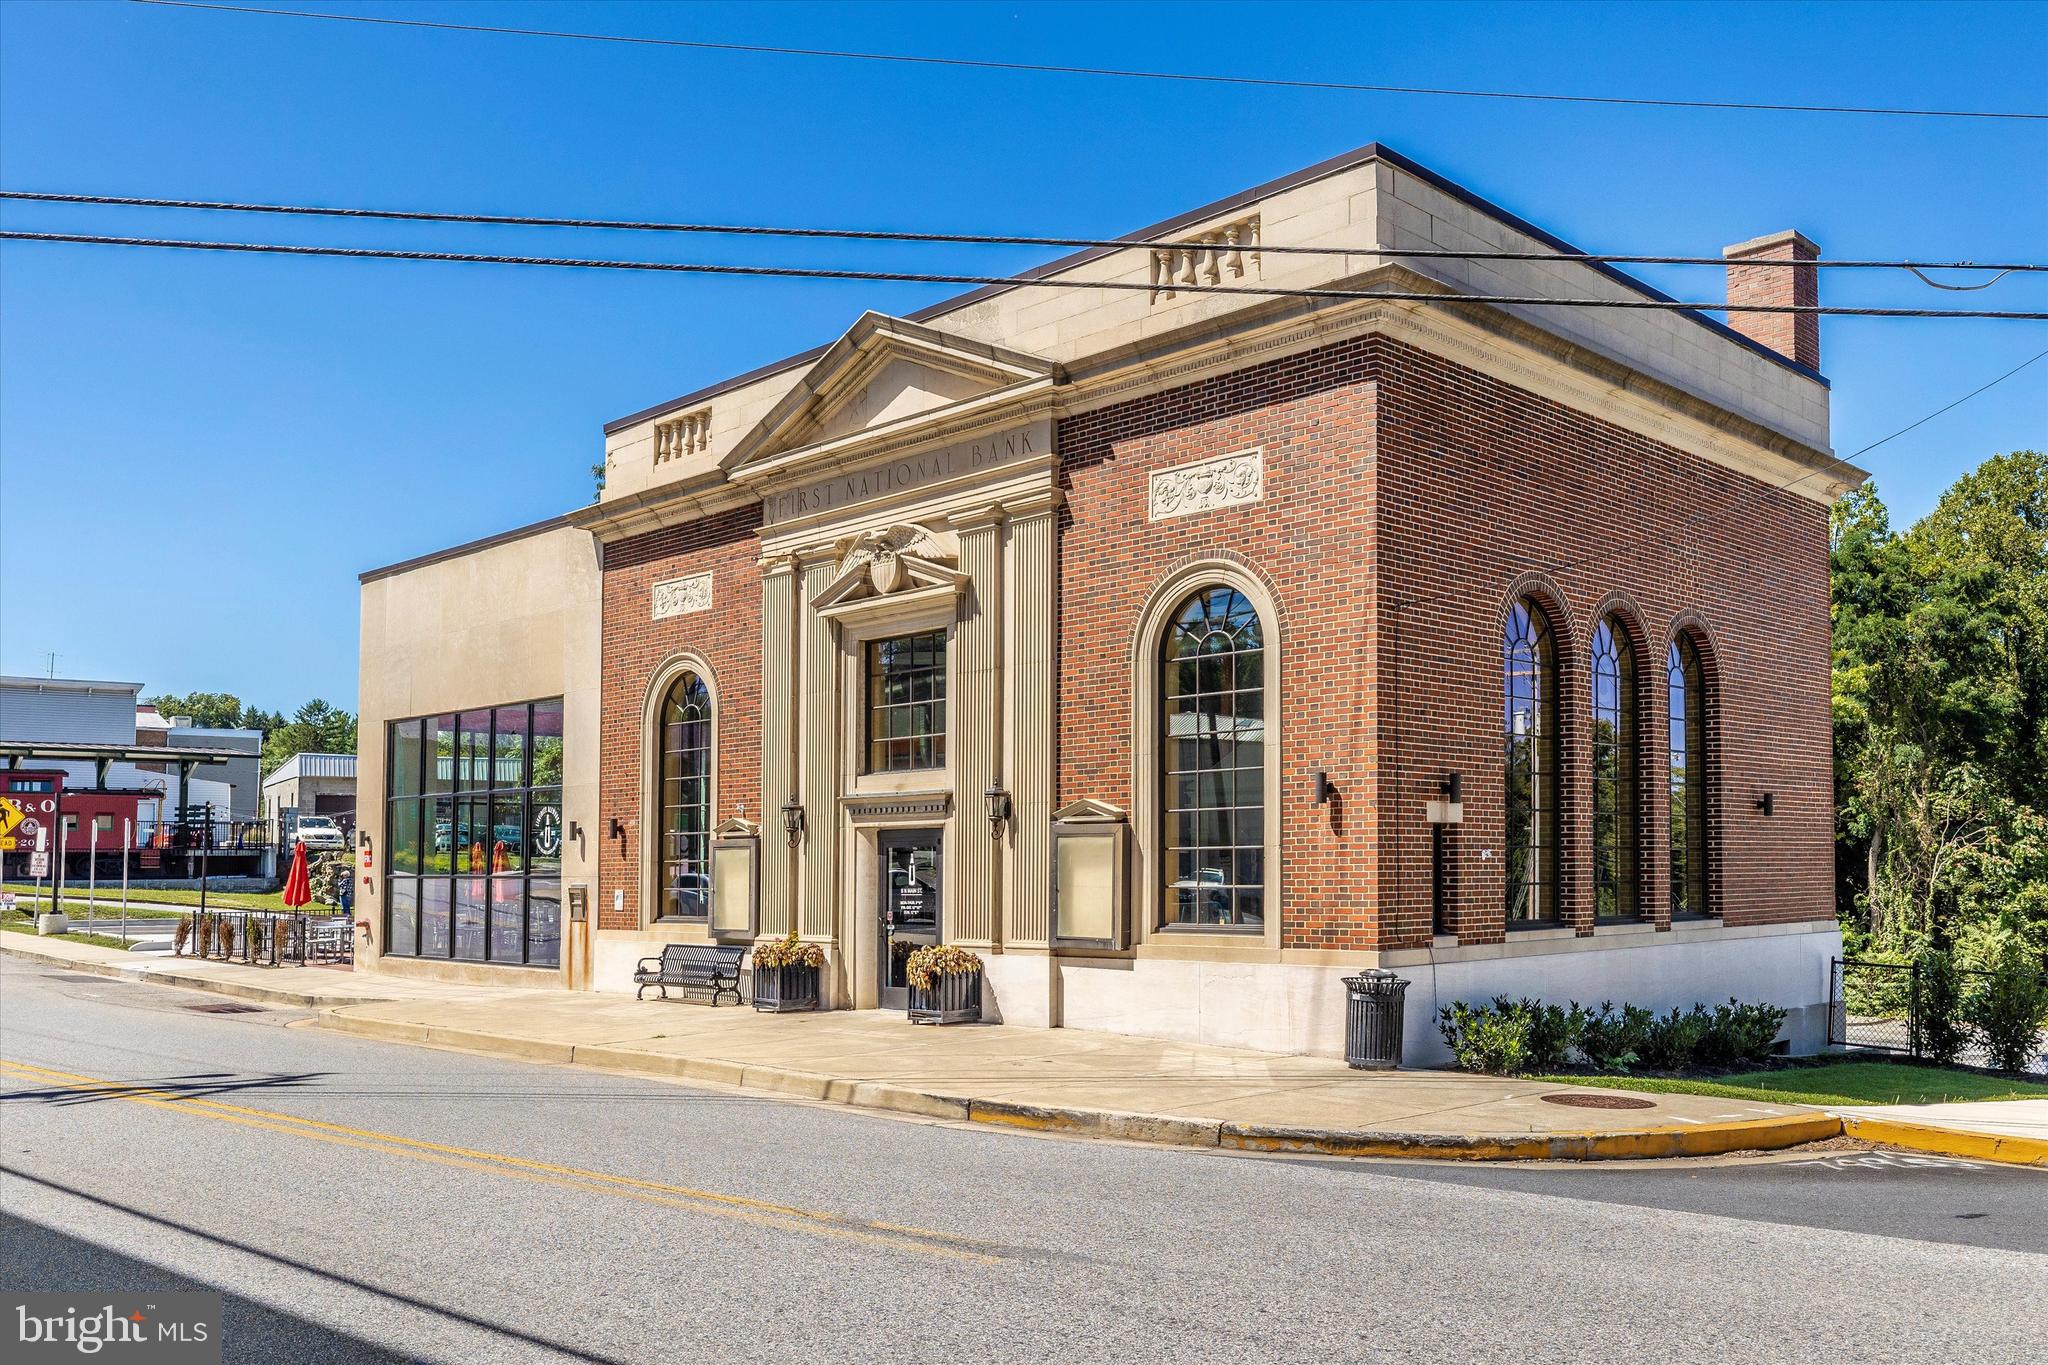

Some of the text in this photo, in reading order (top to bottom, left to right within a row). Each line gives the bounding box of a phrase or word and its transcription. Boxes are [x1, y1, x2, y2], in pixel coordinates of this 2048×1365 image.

[779, 431, 1033, 518] FIRST NATIONAL BANK
[25, 802, 36, 812] &
[41, 799, 56, 812] O
